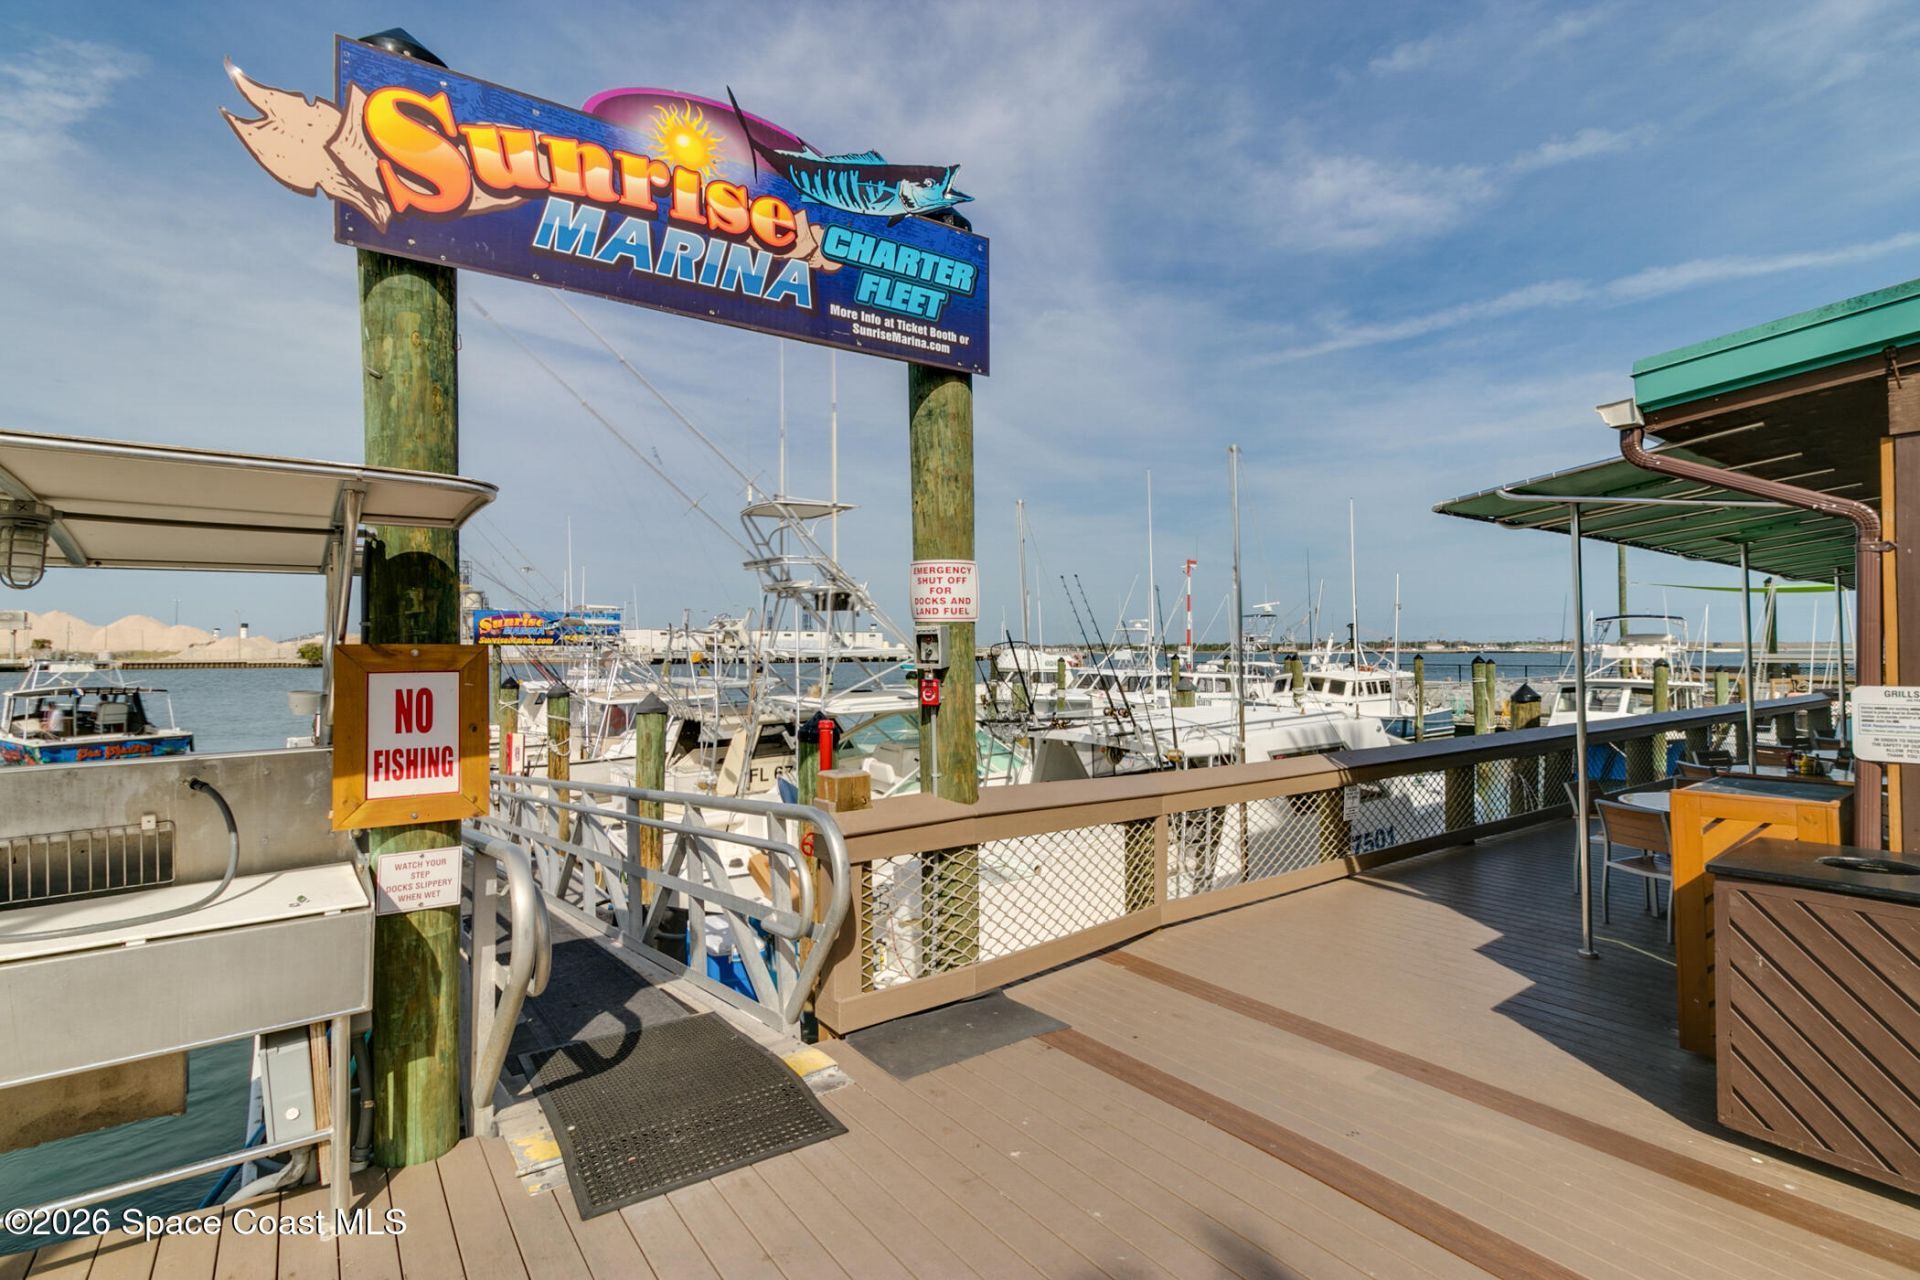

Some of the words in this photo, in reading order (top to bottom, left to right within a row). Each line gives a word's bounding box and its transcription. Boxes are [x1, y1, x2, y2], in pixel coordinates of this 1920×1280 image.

[364, 86, 798, 248] Sunrise
[532, 197, 812, 309] MARINA
[822, 224, 976, 292] CHARTER
[857, 272, 947, 319] FLEET
[830, 304, 858, 320] More
[861, 311, 881, 326] Info
[884, 317, 895, 329] at
[897, 319, 928, 336] Ticket
[930, 326, 956, 343] Booth
[959, 335, 970, 346] or
[852, 323, 950, 354] SunriseMarina.com
[913, 566, 972, 575] EMERGENCY
[917, 576, 943, 585] SHUT
[947, 576, 967, 584] OFF
[929, 586, 952, 595] FOR
[914, 597, 947, 605] DOCKS
[950, 597, 971, 605] AND
[916, 607, 939, 615] LAND
[943, 607, 970, 615] FUEL
[395, 687, 433, 734] NO
[373, 745, 454, 782] FISHING
[750, 767, 769, 783] FL
[394, 861, 423, 871] WATCH
[426, 858, 447, 867] YOUR
[410, 870, 431, 880] STEP
[385, 883, 413, 894] DOCKS
[415, 878, 453, 890] SLIPPERY
[397, 893, 422, 903] WHEN
[424, 890, 441, 899] WET
